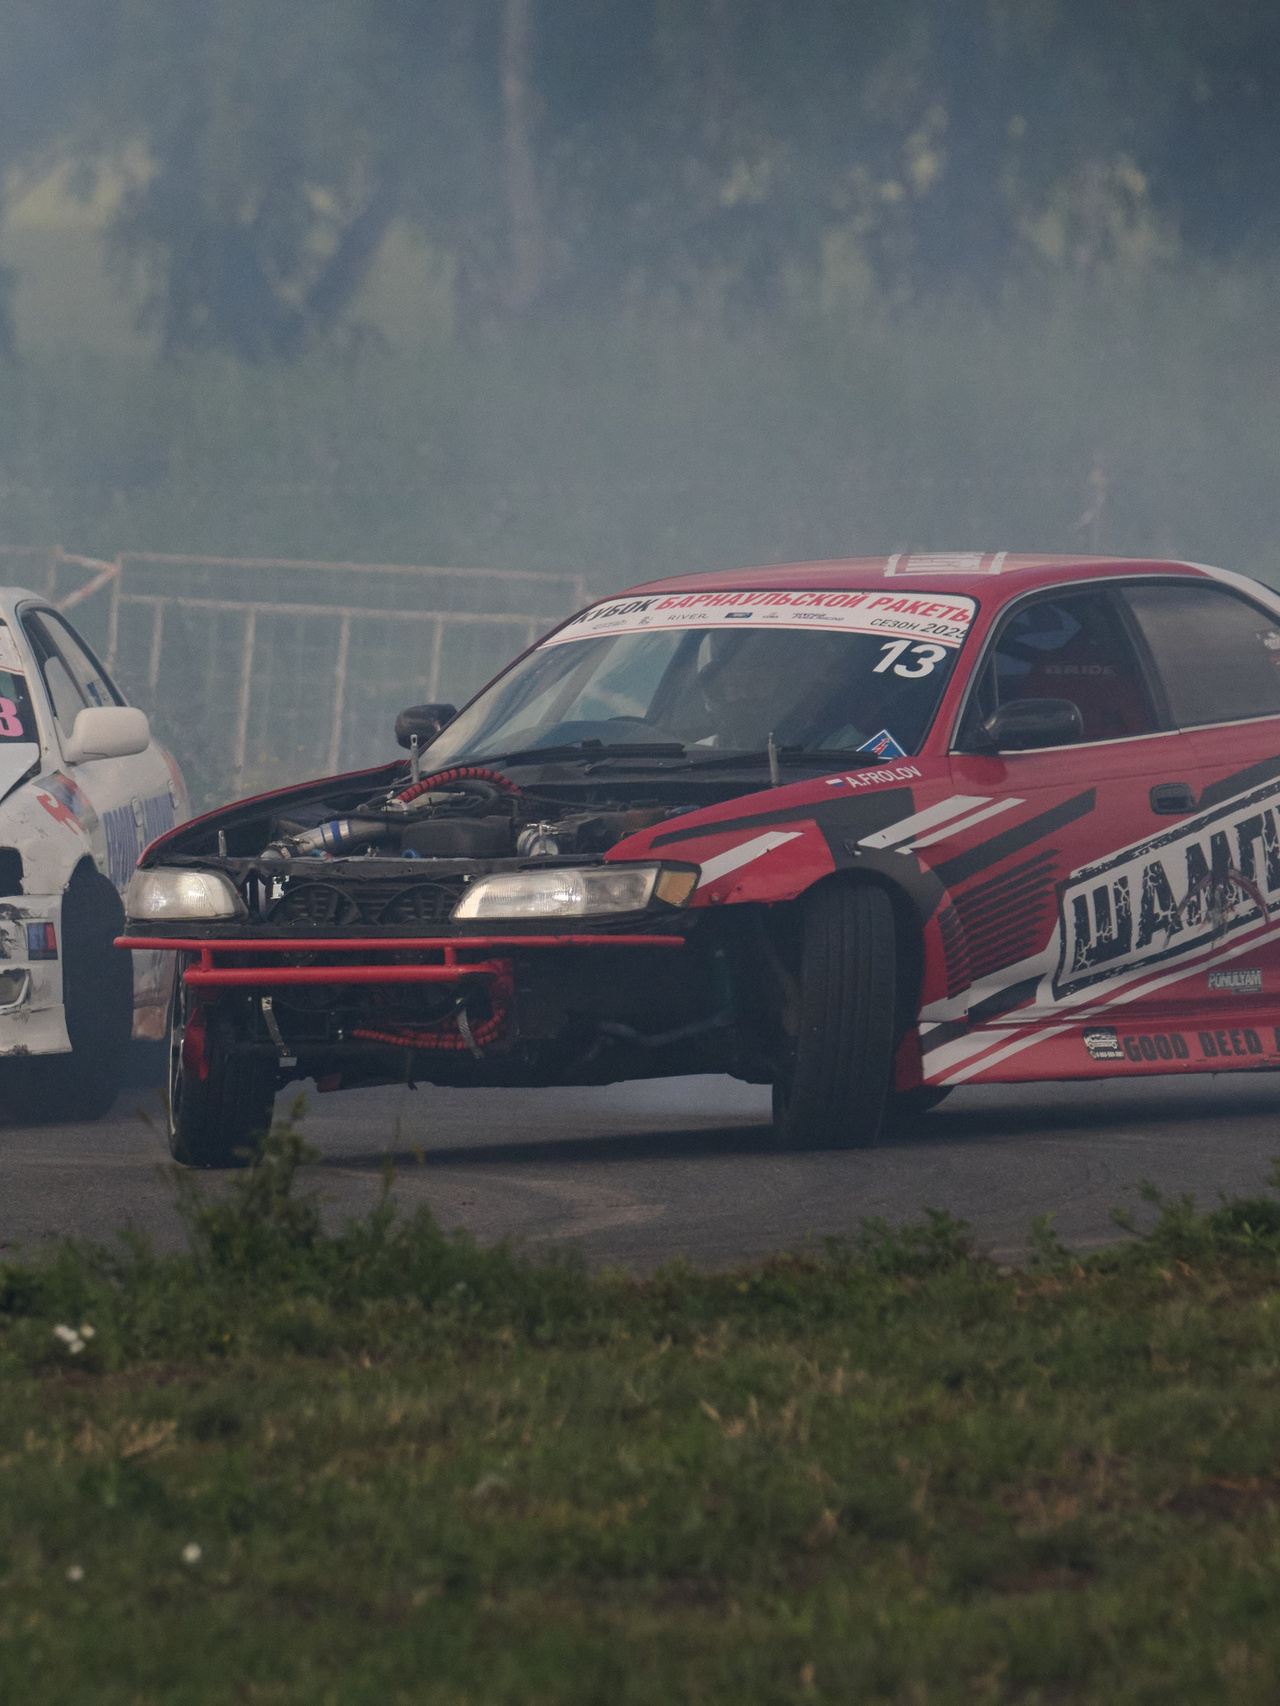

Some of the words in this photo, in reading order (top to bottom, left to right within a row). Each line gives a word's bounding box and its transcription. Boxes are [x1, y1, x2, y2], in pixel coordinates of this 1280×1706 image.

[572, 598, 660, 626] КУБОК
[654, 592, 870, 611] БАРНАУЛЬСКОЙ
[870, 618, 921, 631] СЕЗОН
[872, 639, 947, 679] 13
[845, 765, 922, 788] A.FROLOV
[1123, 1032, 1190, 1062] GOOD
[1198, 1028, 1263, 1058] DEED
